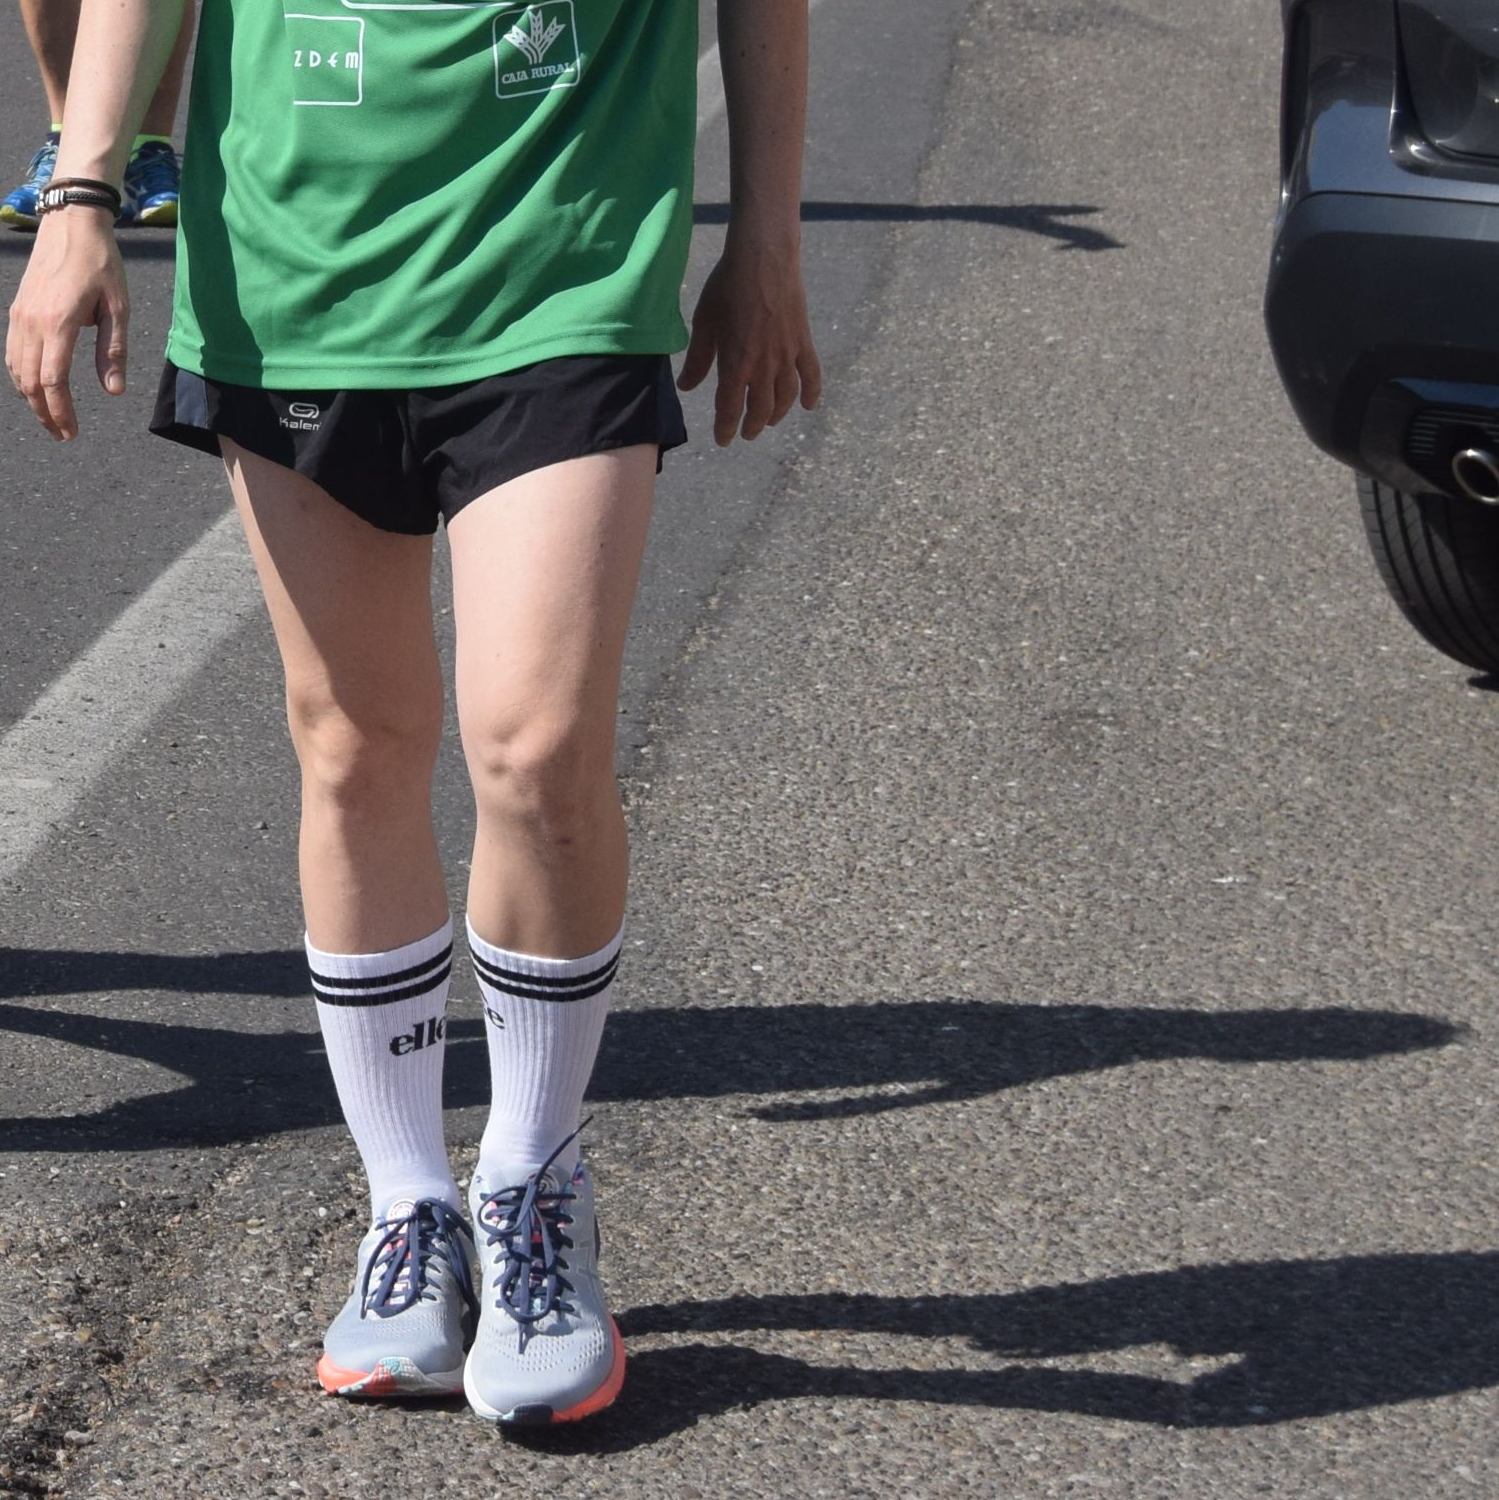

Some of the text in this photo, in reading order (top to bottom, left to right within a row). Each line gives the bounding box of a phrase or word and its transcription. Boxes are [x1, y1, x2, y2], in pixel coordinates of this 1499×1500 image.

[501, 61, 575, 85] CAJA RURAL
[279, 417, 322, 431] Kalen
